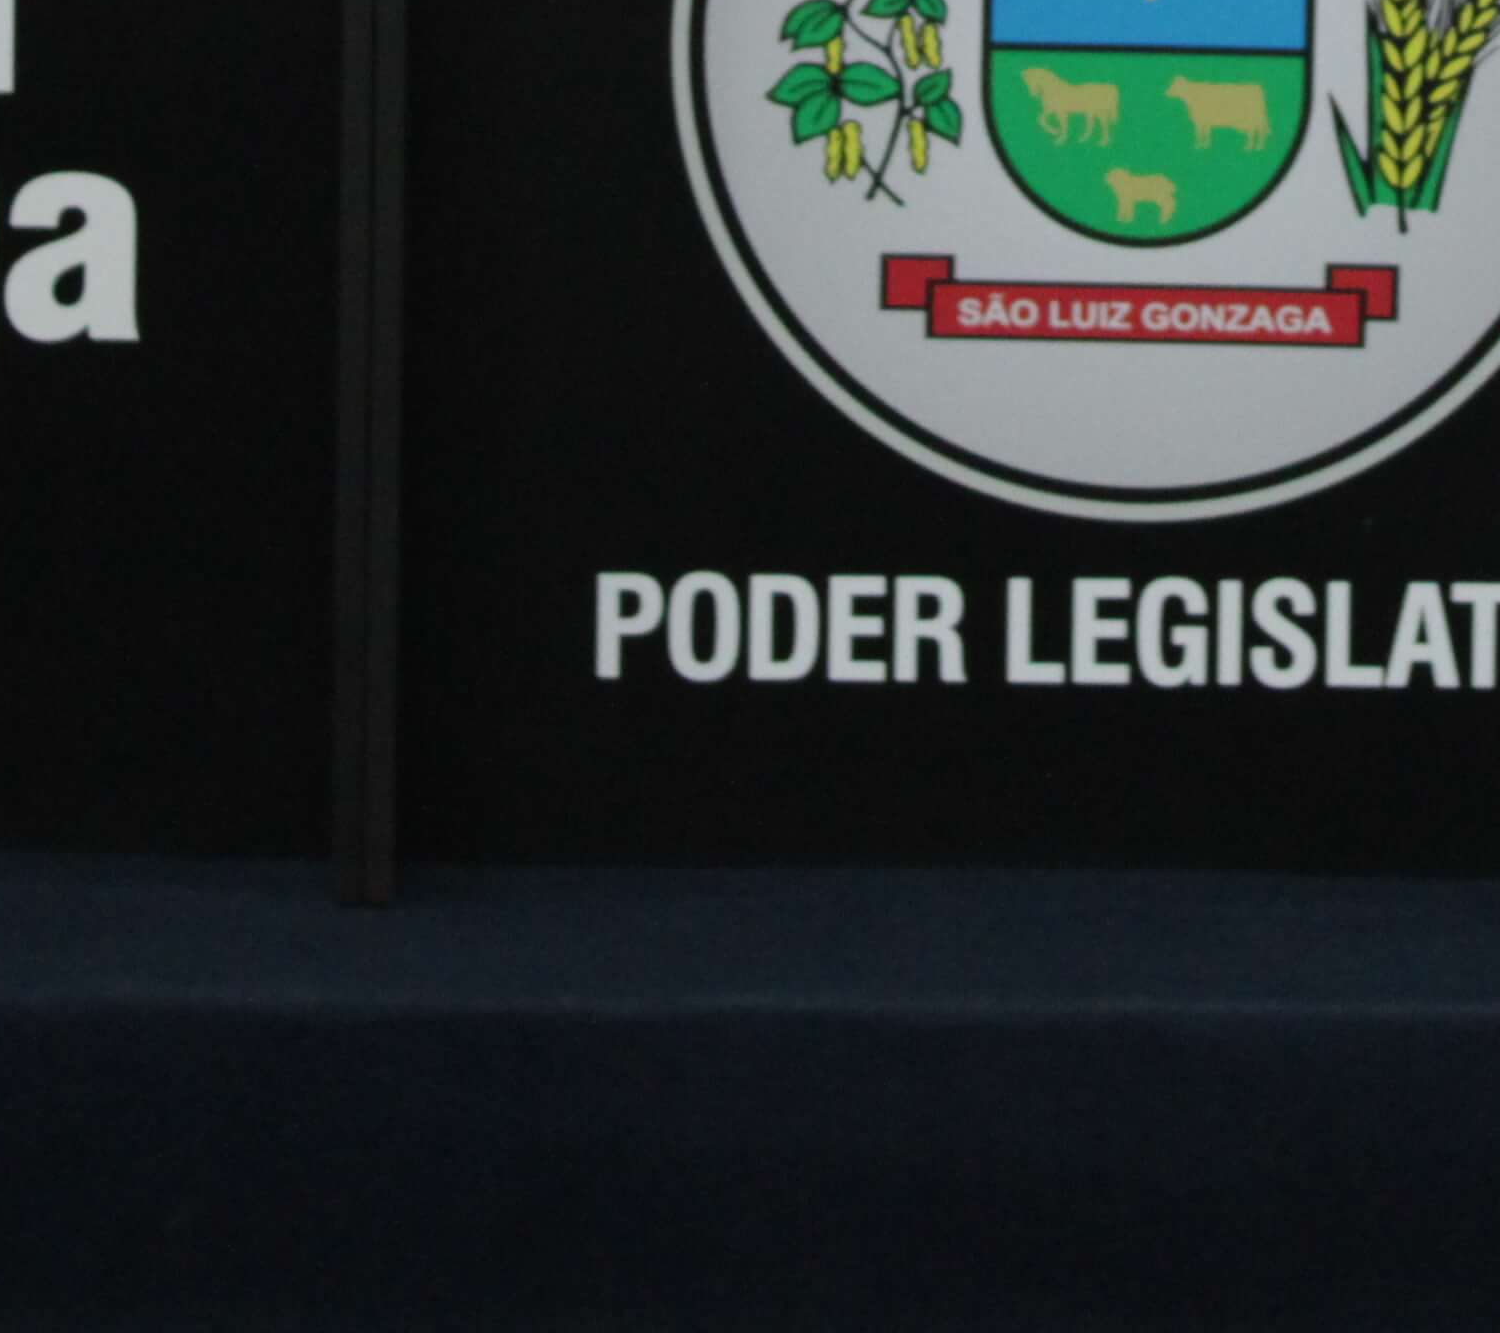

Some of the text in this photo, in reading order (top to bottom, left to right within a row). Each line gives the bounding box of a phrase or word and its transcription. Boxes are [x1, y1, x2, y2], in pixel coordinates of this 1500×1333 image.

[957, 291, 1332, 335] SÃO LUIZ GONZAGA
[595, 570, 967, 683] PODER
